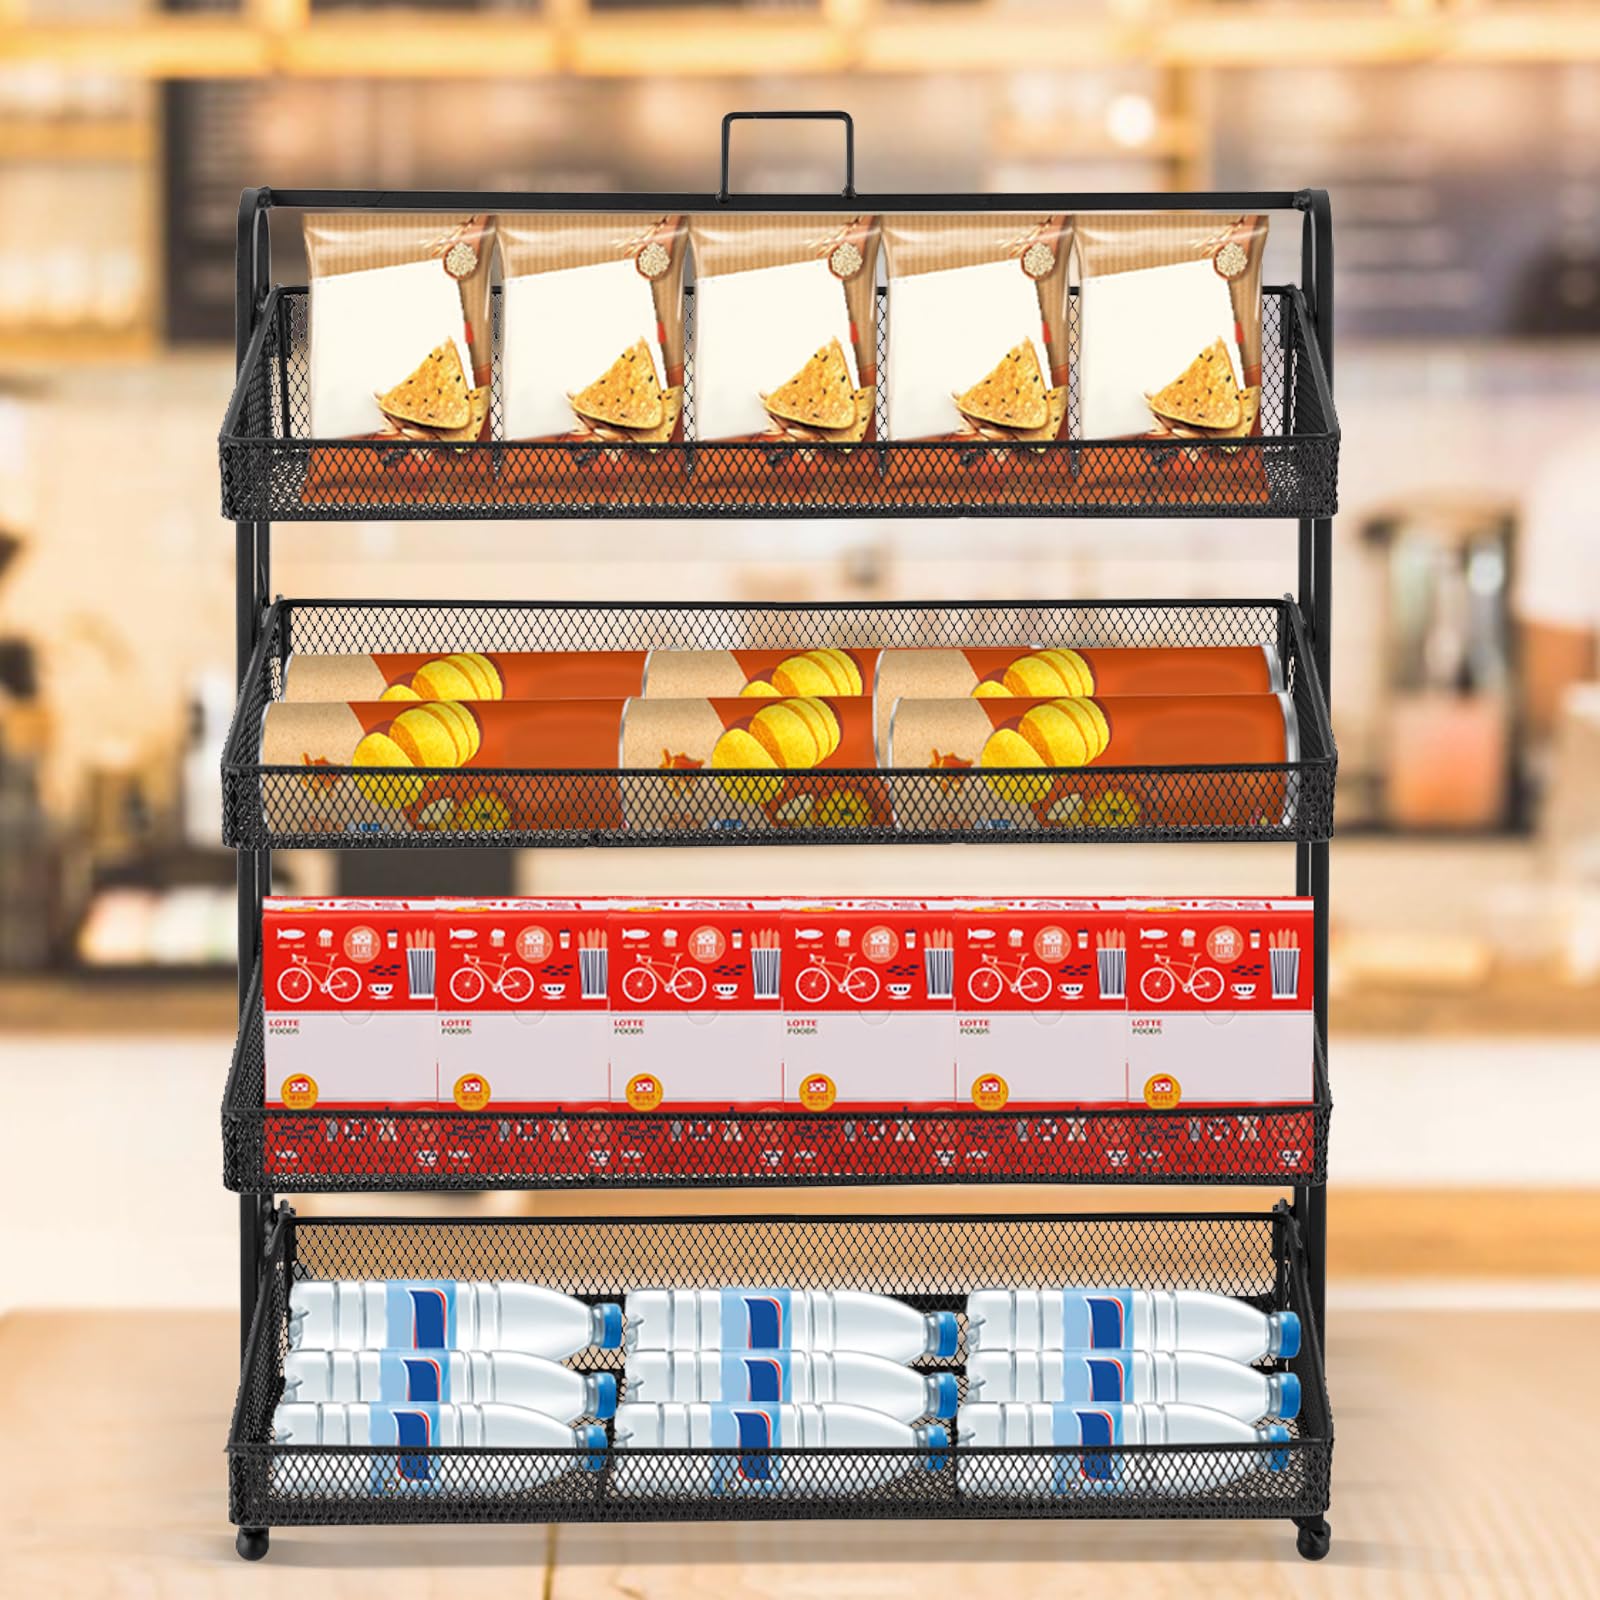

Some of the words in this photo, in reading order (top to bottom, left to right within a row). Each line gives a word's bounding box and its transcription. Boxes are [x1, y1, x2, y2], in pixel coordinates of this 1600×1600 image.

[269, 1019, 298, 1028] LOTTE
[441, 1019, 470, 1028] LOTTE
[614, 1019, 643, 1028] LOTTE
[787, 1019, 816, 1028] LOTTE
[960, 1019, 989, 1028] LOTTE
[1132, 1019, 1161, 1028] LOTTE
